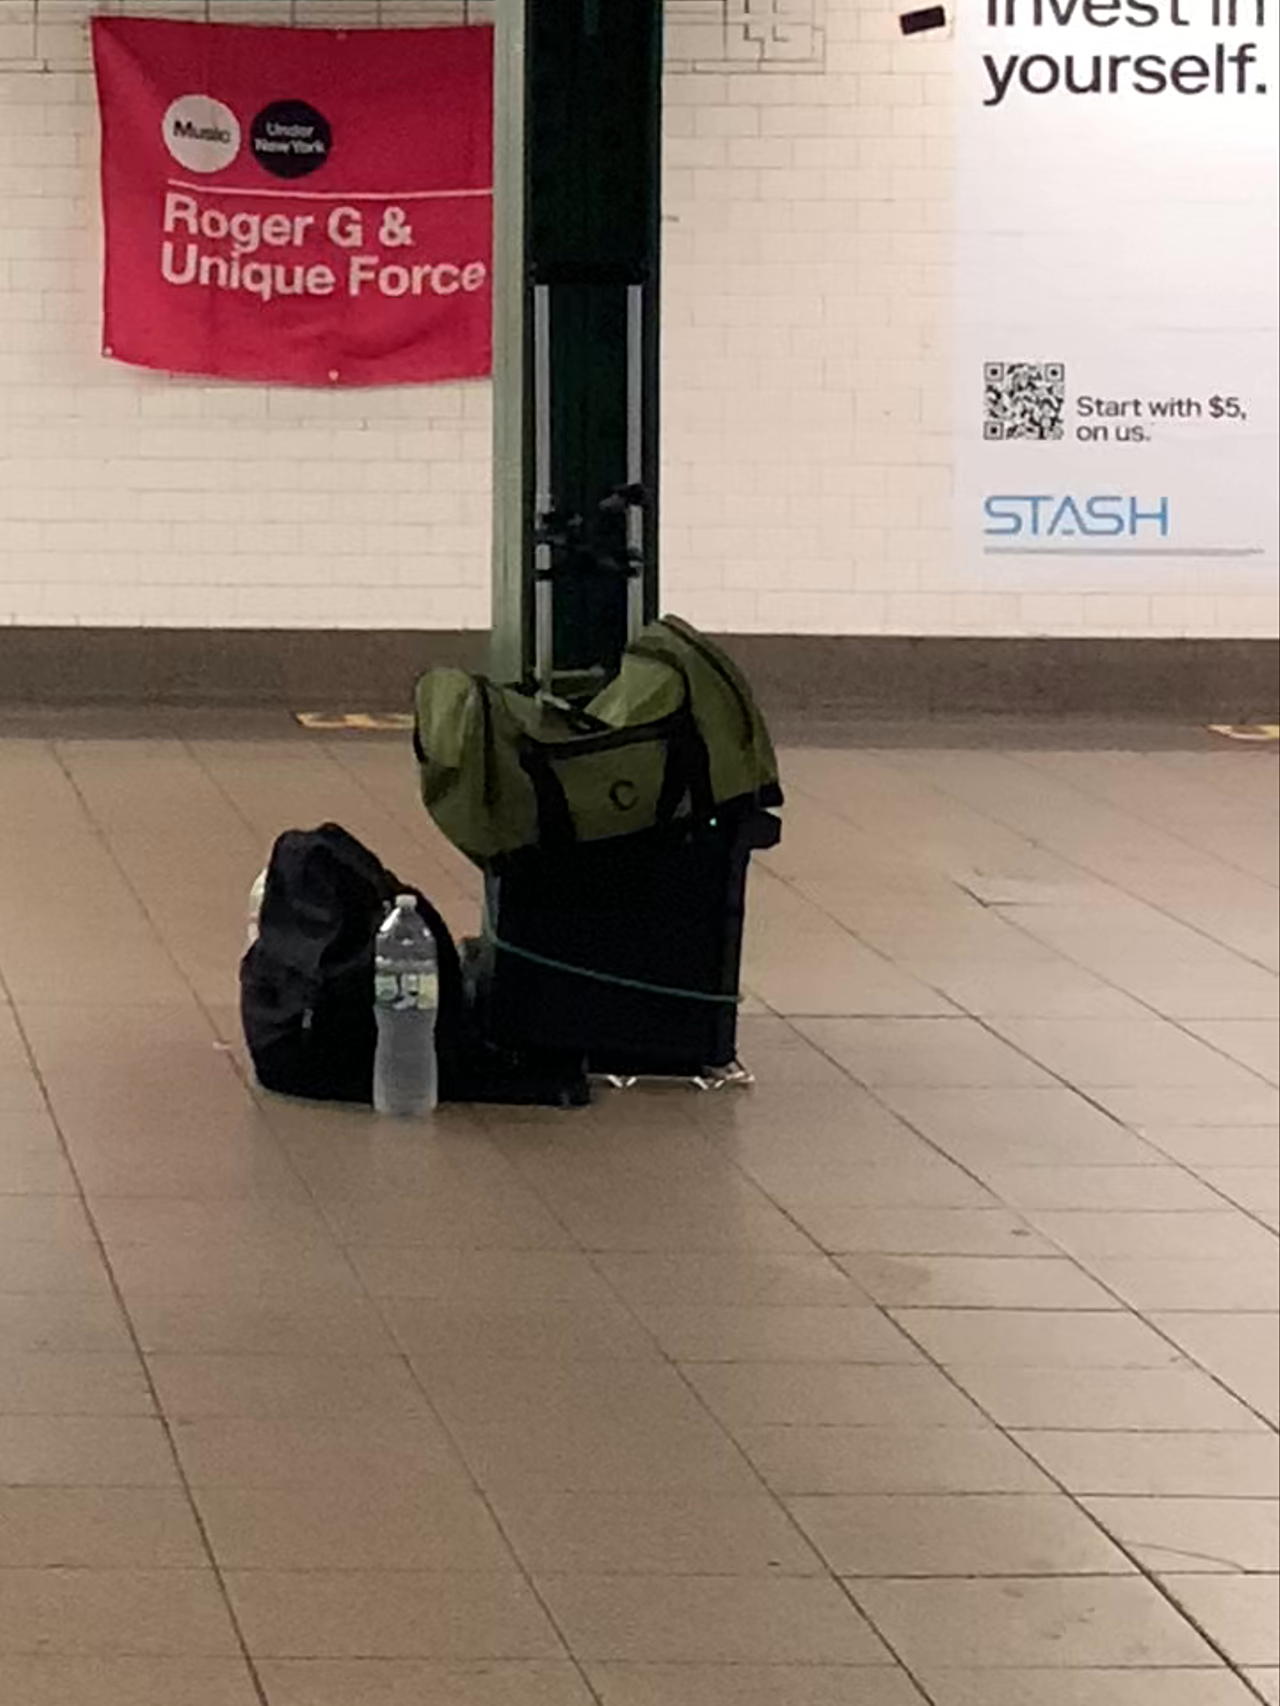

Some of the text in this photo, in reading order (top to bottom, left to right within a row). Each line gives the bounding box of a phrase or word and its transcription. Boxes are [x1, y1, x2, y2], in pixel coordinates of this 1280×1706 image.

[982, 42, 1267, 106] yourself.
[174, 120, 231, 143] Music
[266, 122, 315, 137] Under
[163, 191, 414, 253] Roger G &
[161, 241, 486, 301] Unique Force
[1076, 395, 1247, 420] Start with $5,
[1076, 425, 1151, 442] on us.
[984, 495, 1169, 536] STASH
